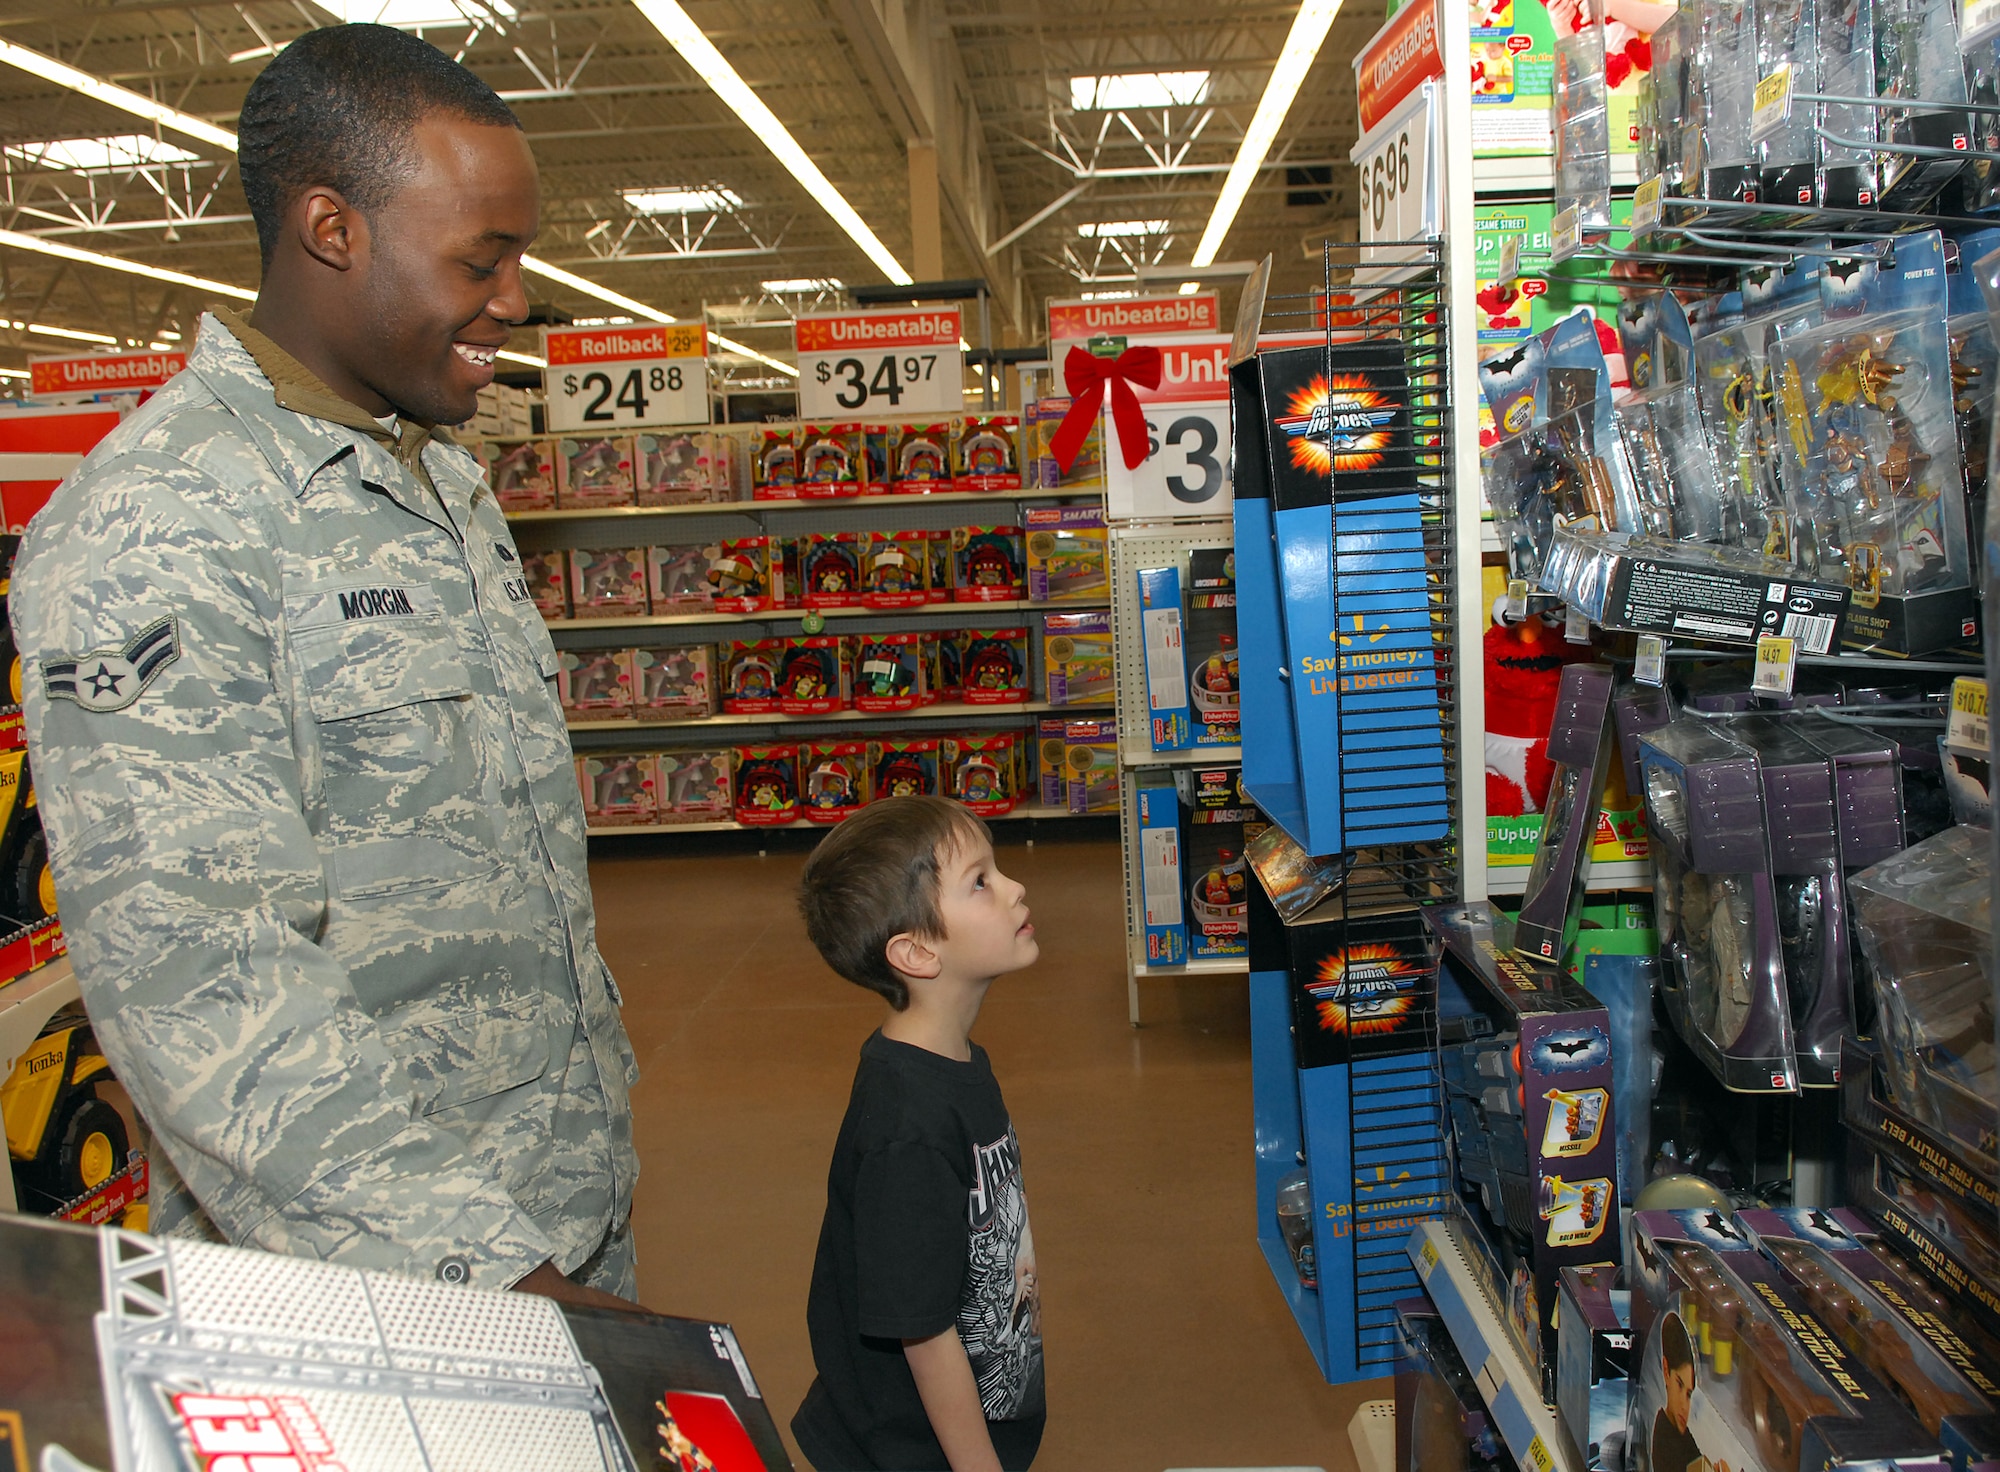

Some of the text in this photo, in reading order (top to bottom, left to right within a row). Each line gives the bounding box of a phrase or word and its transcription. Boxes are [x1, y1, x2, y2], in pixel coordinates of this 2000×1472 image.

[1373, 16, 1434, 90] Unbeatable
[1500, 218, 1525, 230] STREET
[1904, 268, 1923, 281] POWER
[1085, 300, 1210, 328] Unbeatable
[831, 314, 953, 341] Unbeatable
[581, 333, 665, 357] Rollback
[64, 354, 181, 385] Unbeatable
[1312, 402, 1362, 418] Combat
[1063, 508, 1104, 521] SMART
[338, 589, 414, 620] MORGAN
[1847, 613, 1869, 626] FLAME
[1870, 616, 1890, 629] SHOT
[1854, 625, 1884, 639] BATMAN
[1302, 650, 1424, 674] Save money.
[1762, 648, 1781, 664] $4.97
[1310, 670, 1419, 696] Live better.
[1212, 808, 1256, 823] NASCAR
[1498, 828, 1517, 844] Up
[1197, 945, 1246, 955] Little People
[1497, 963, 1538, 991] BLASTER
[26, 1051, 63, 1076] Tonka
[1880, 1118, 1908, 1143] BELT
[1559, 1143, 1582, 1152] MISSILE
[1907, 1136, 1948, 1173] UTILITY
[1919, 1158, 1939, 1177] TECH
[1949, 1160, 1973, 1187] FIRE
[109, 1192, 125, 1211] Truck
[1326, 1200, 1369, 1218] Save
[1333, 1222, 1371, 1238] Live
[1882, 1209, 1909, 1235] BELT
[1574, 1231, 1592, 1241] WRAP
[1908, 1228, 1945, 1265] UTILITY
[1918, 1252, 1936, 1273] TECH
[1945, 1256, 1968, 1284] FIRE
[1752, 1281, 1871, 1401] RAPID FIRE UTILITY BELT
[1799, 1313, 1847, 1360] WAYNE TECH
[1869, 1279, 2000, 1396] RAPID FIRE UTILITY BELT
[1922, 1311, 1976, 1358] WAYNE TECH
